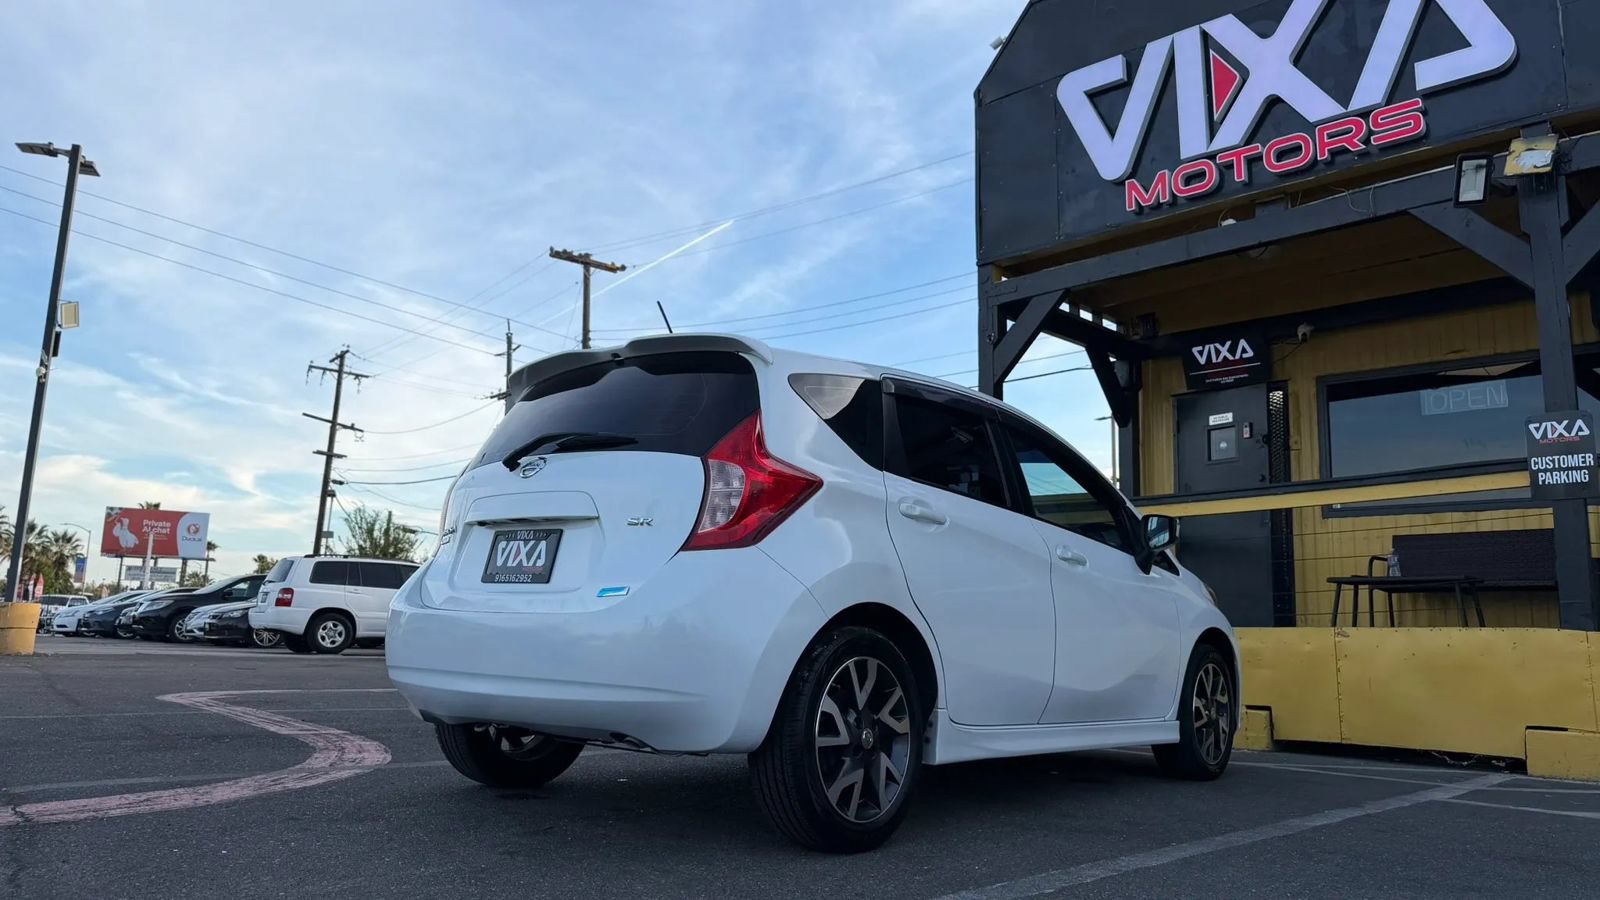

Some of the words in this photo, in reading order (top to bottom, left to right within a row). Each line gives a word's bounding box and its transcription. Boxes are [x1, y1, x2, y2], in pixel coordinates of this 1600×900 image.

[1057, 0, 1517, 181] VIXA
[1125, 97, 1425, 212] MOTORS
[1192, 338, 1254, 365] VIXA
[1430, 384, 1504, 411] OPEN
[1528, 418, 1591, 440] VIXA
[1539, 436, 1581, 444] MOTORS
[1531, 453, 1594, 471] CUSTOMER
[1538, 469, 1589, 486] PARKING
[143, 519, 171, 528] Private
[627, 517, 654, 527] SR
[517, 530, 534, 540] VIXA
[496, 540, 547, 567] VIXA
[494, 573, 532, 582] 9165162952
